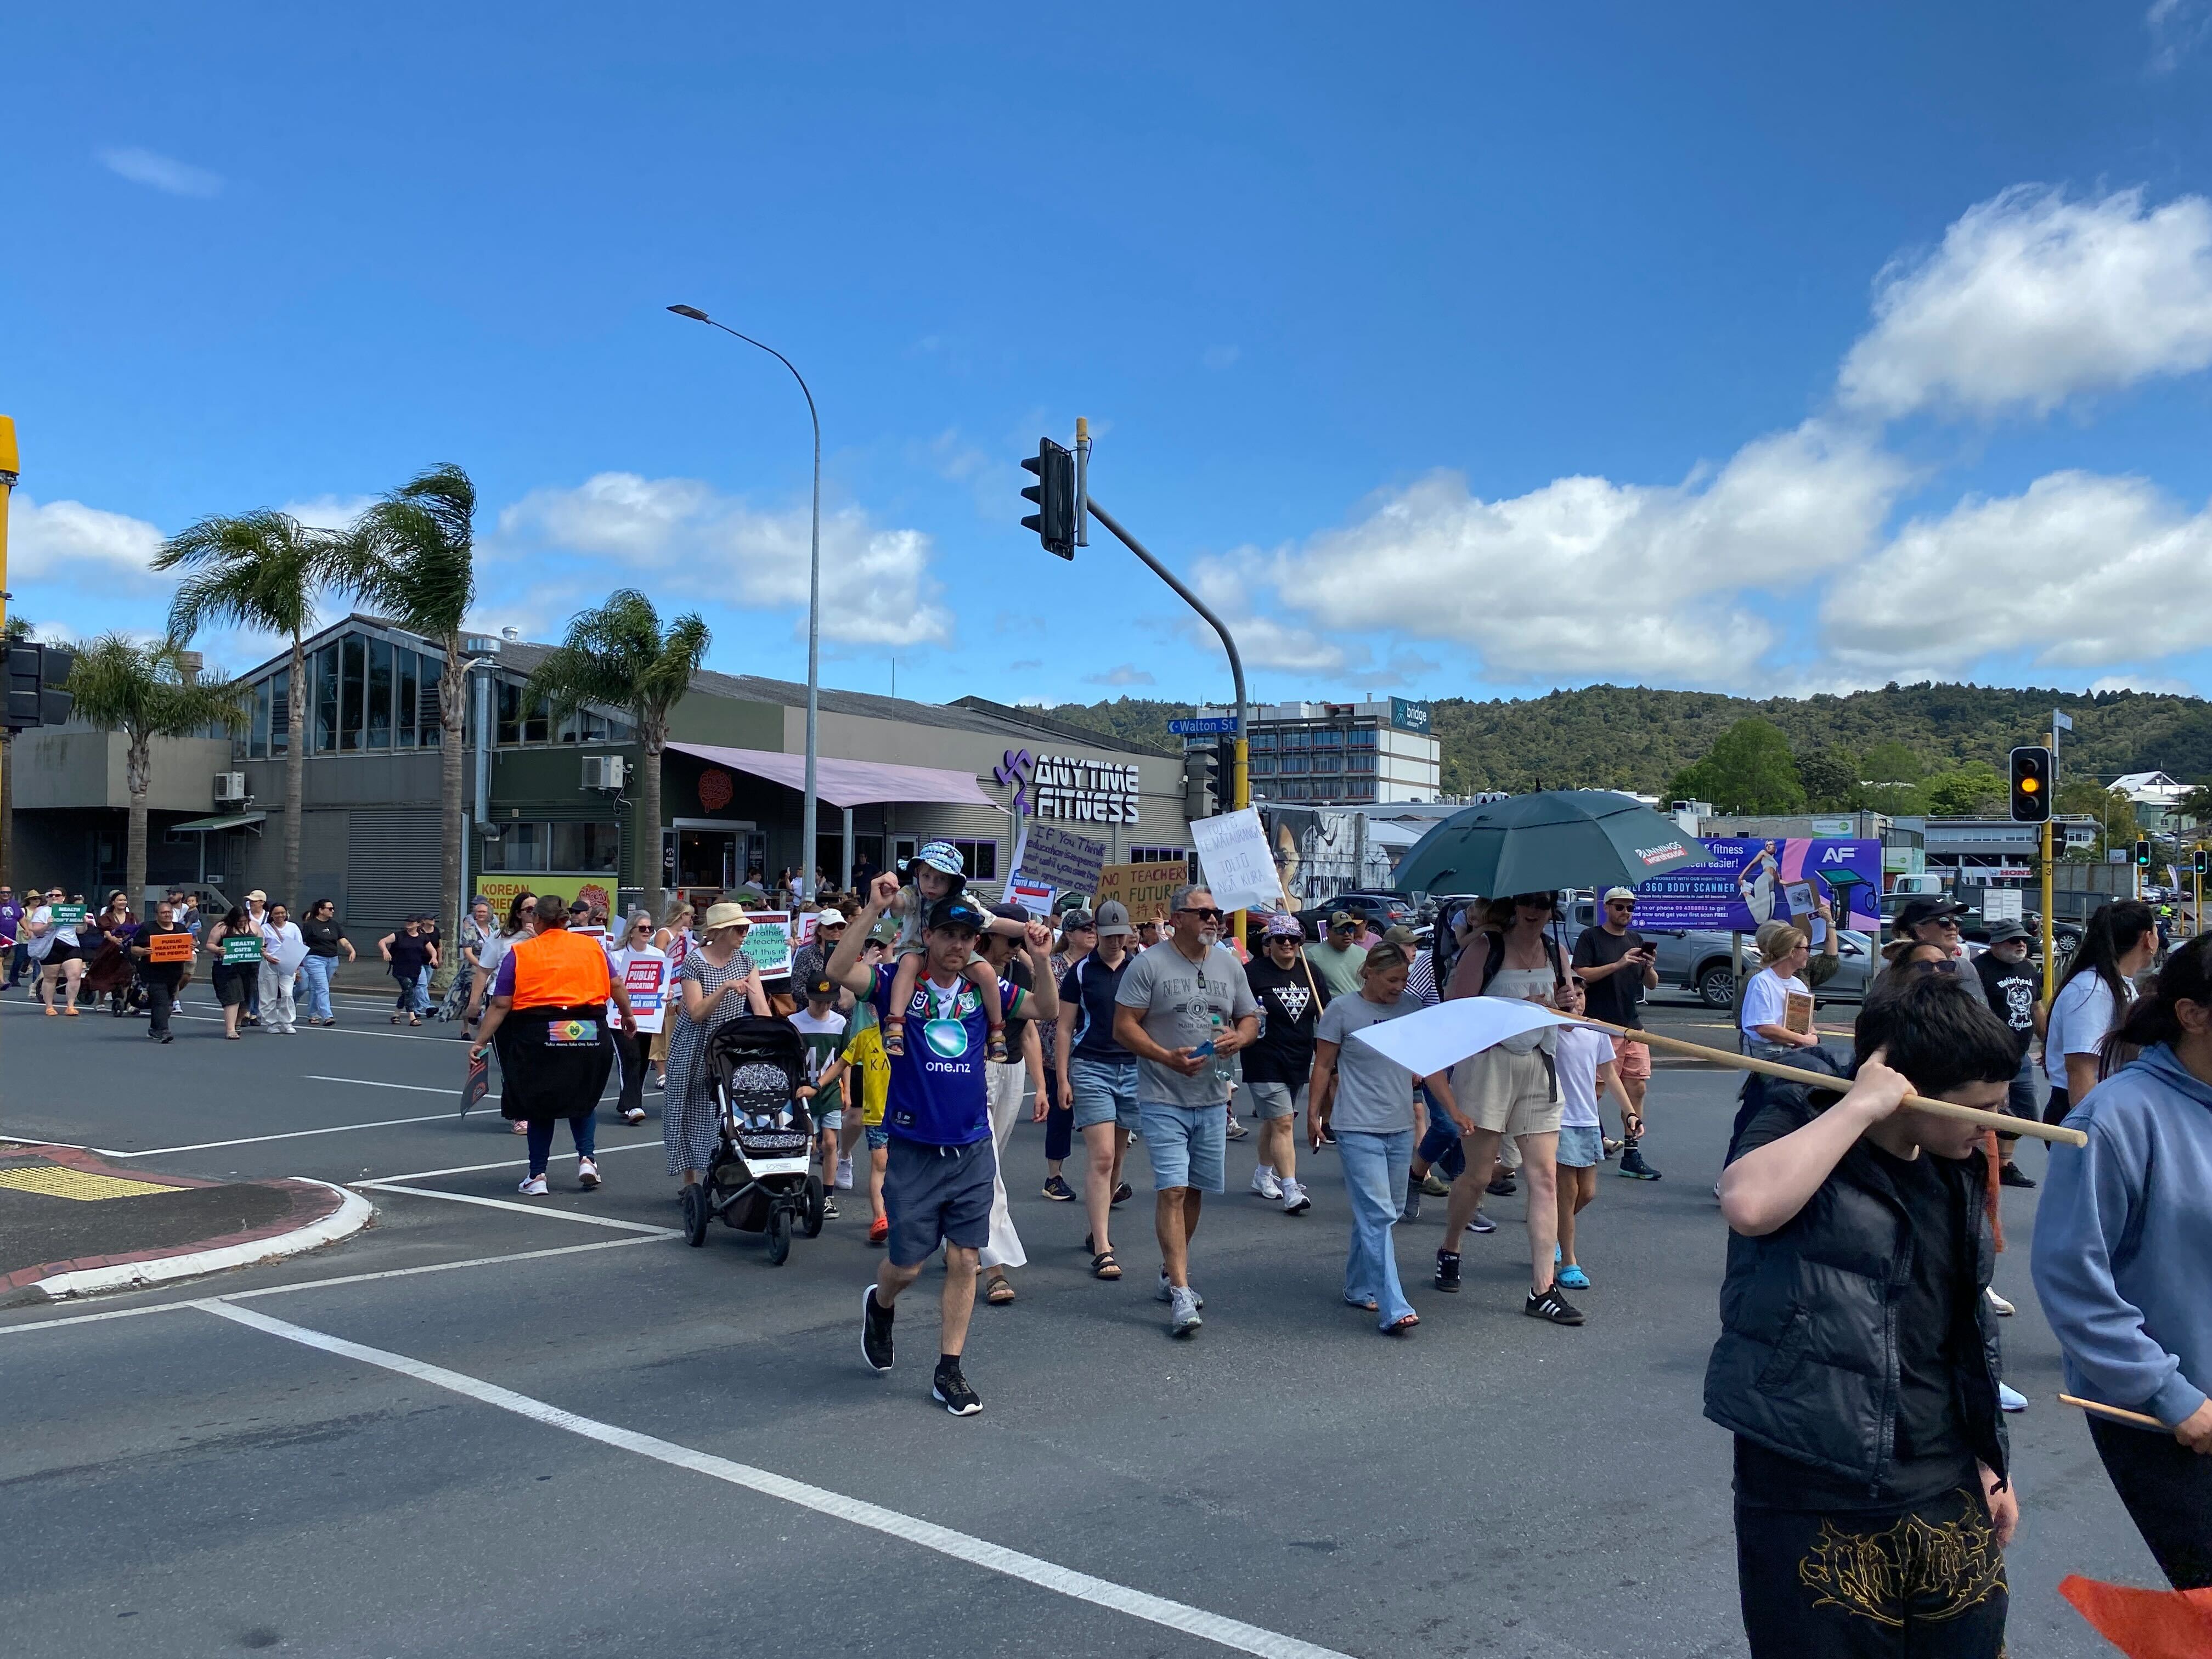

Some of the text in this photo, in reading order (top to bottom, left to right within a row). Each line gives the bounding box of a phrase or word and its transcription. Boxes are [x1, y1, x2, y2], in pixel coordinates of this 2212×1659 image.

[1407, 703, 1426, 724] bridge
[1180, 719, 1233, 731] Walton St
[1035, 754, 1138, 792] ANYTIME
[1038, 787, 1139, 822] FITNESS
[1635, 842, 1681, 859] BUNNINGS
[1713, 844, 1743, 854] fitness
[1646, 850, 1684, 864] warehouse
[1708, 858, 1739, 868] easier!
[1102, 866, 1187, 887] NO TEACHERS
[482, 884, 529, 895] KOREAN
[1646, 883, 1662, 891] 360
[1668, 883, 1690, 892] BODY
[1694, 883, 1735, 892] SCANNER
[628, 970, 657, 980] PUBLIC
[1163, 979, 1190, 997] NEW
[926, 1062, 970, 1073] one.nz
